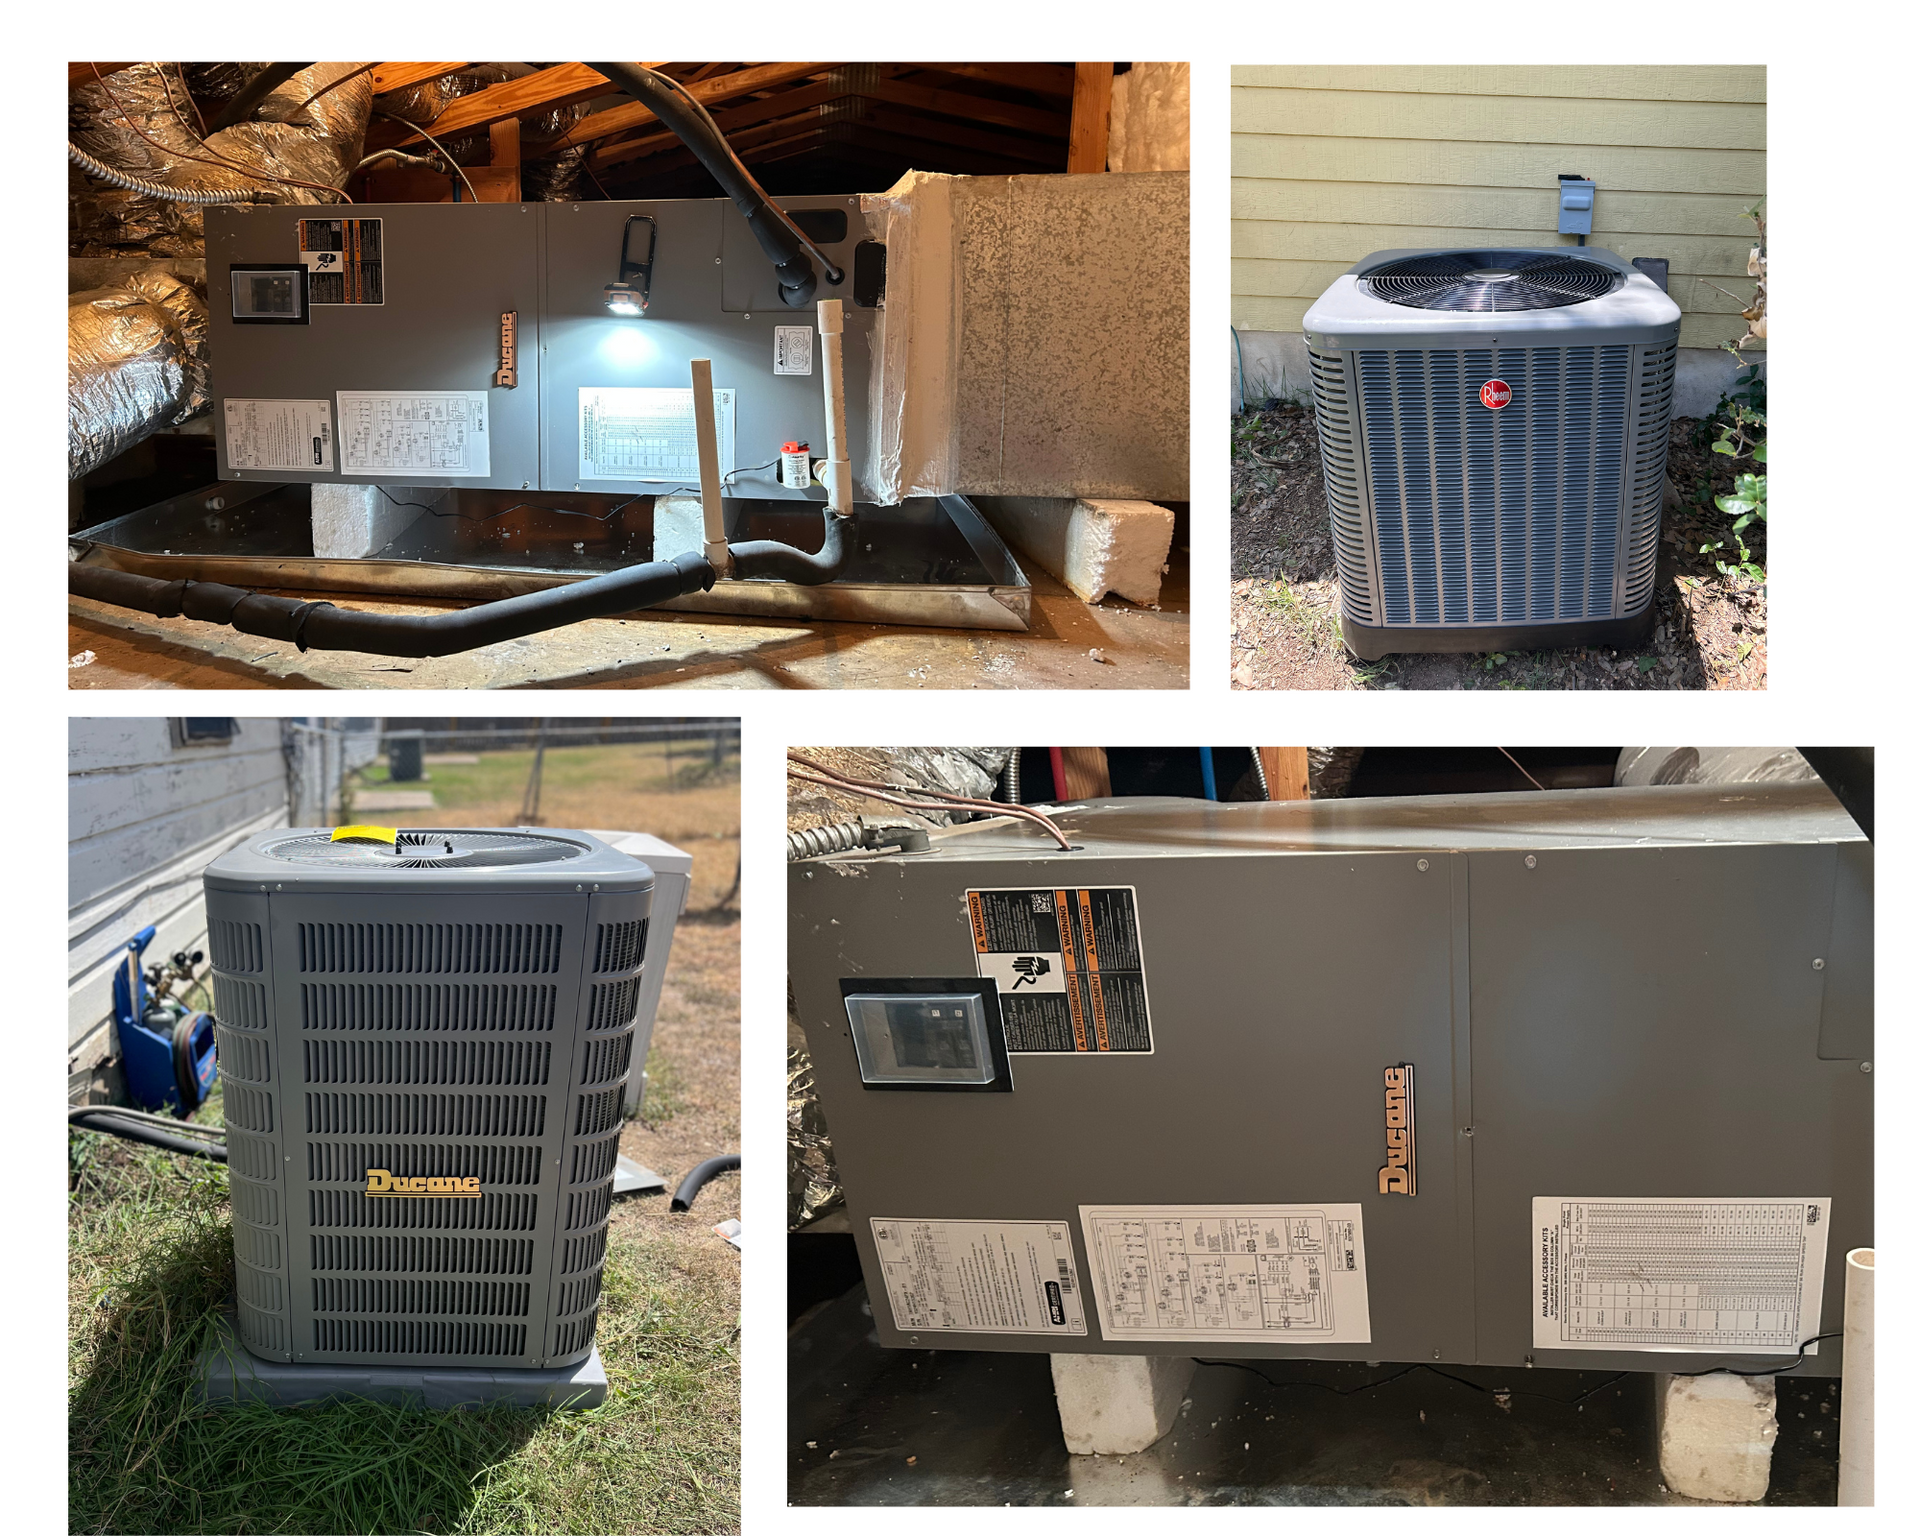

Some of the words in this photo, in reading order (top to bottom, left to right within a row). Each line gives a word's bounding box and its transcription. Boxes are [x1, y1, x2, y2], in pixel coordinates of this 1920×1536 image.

[496, 313, 513, 385] Ducane
[1484, 382, 1509, 405] Rheem
[972, 897, 984, 937] WARNING
[1060, 905, 1071, 946] WARNING
[1083, 905, 1094, 946] WARNING
[1069, 975, 1084, 1040] AVERTISSEMENT
[1092, 975, 1106, 1040] AVERTISSEMENT
[1378, 1068, 1407, 1194] Ducane
[366, 1168, 480, 1192] Ducane
